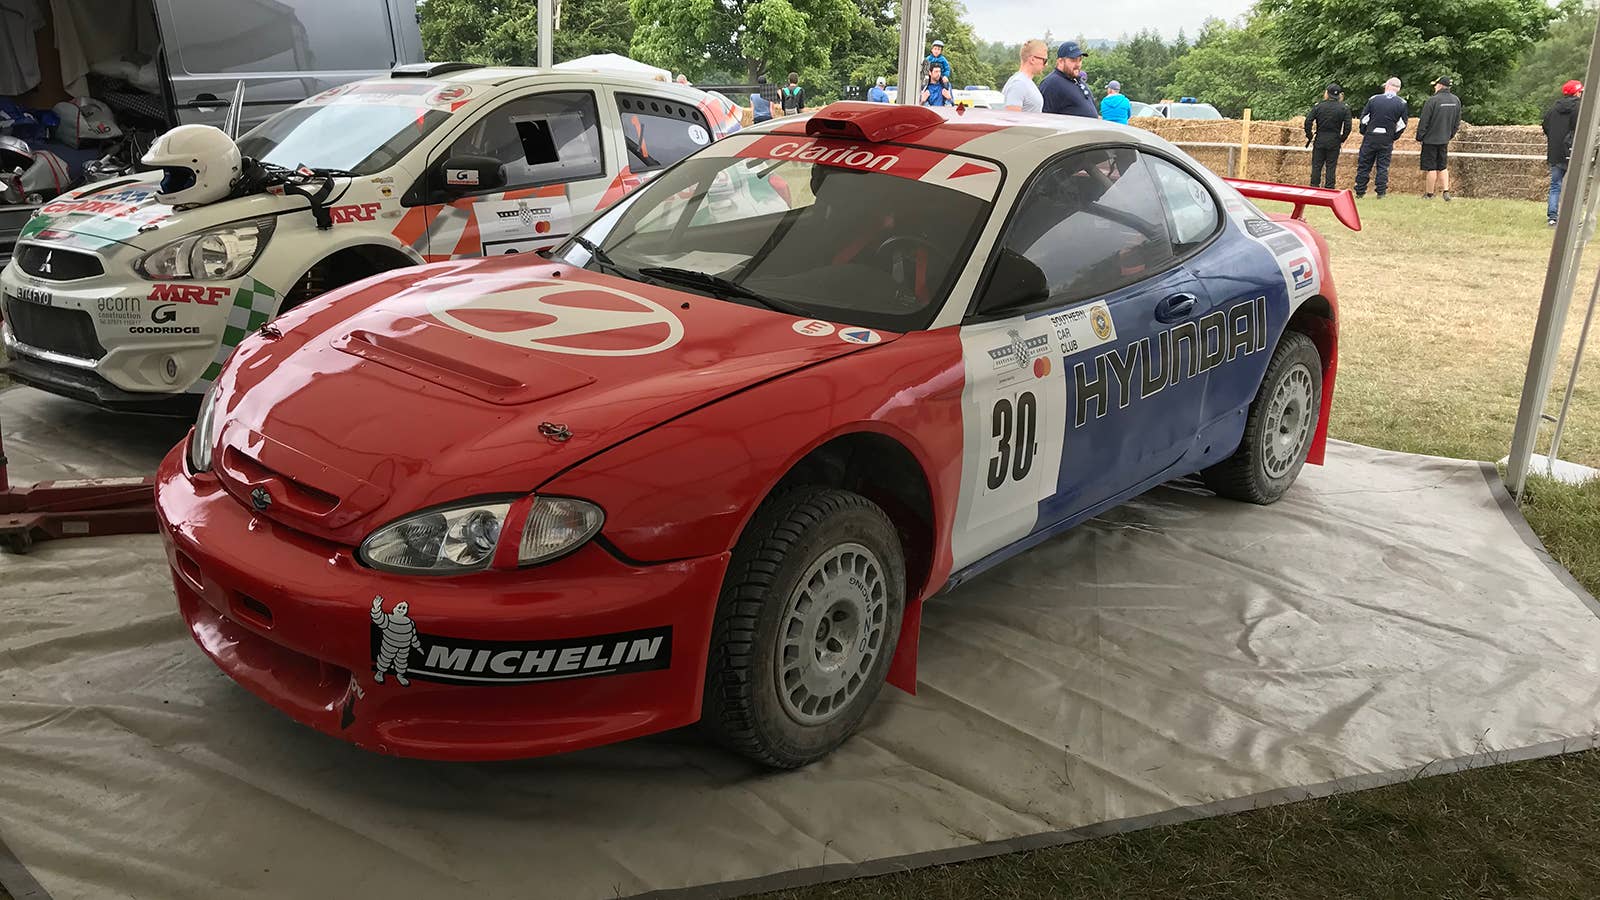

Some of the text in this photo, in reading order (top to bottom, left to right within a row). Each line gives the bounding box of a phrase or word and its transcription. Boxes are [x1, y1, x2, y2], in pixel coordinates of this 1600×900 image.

[769, 141, 900, 171] Clarion
[97, 297, 141, 312] acorn
[147, 284, 231, 306] MRF
[98, 312, 142, 320] construction
[1050, 309, 1088, 328] SOUTHERN
[129, 326, 200, 334] GOODRIDGE
[1056, 327, 1072, 341] CAR
[1060, 340, 1079, 354] CLUB
[1074, 295, 1267, 429] HYUNDAI
[987, 391, 1037, 490] 30
[424, 636, 664, 674] MICHELIN
